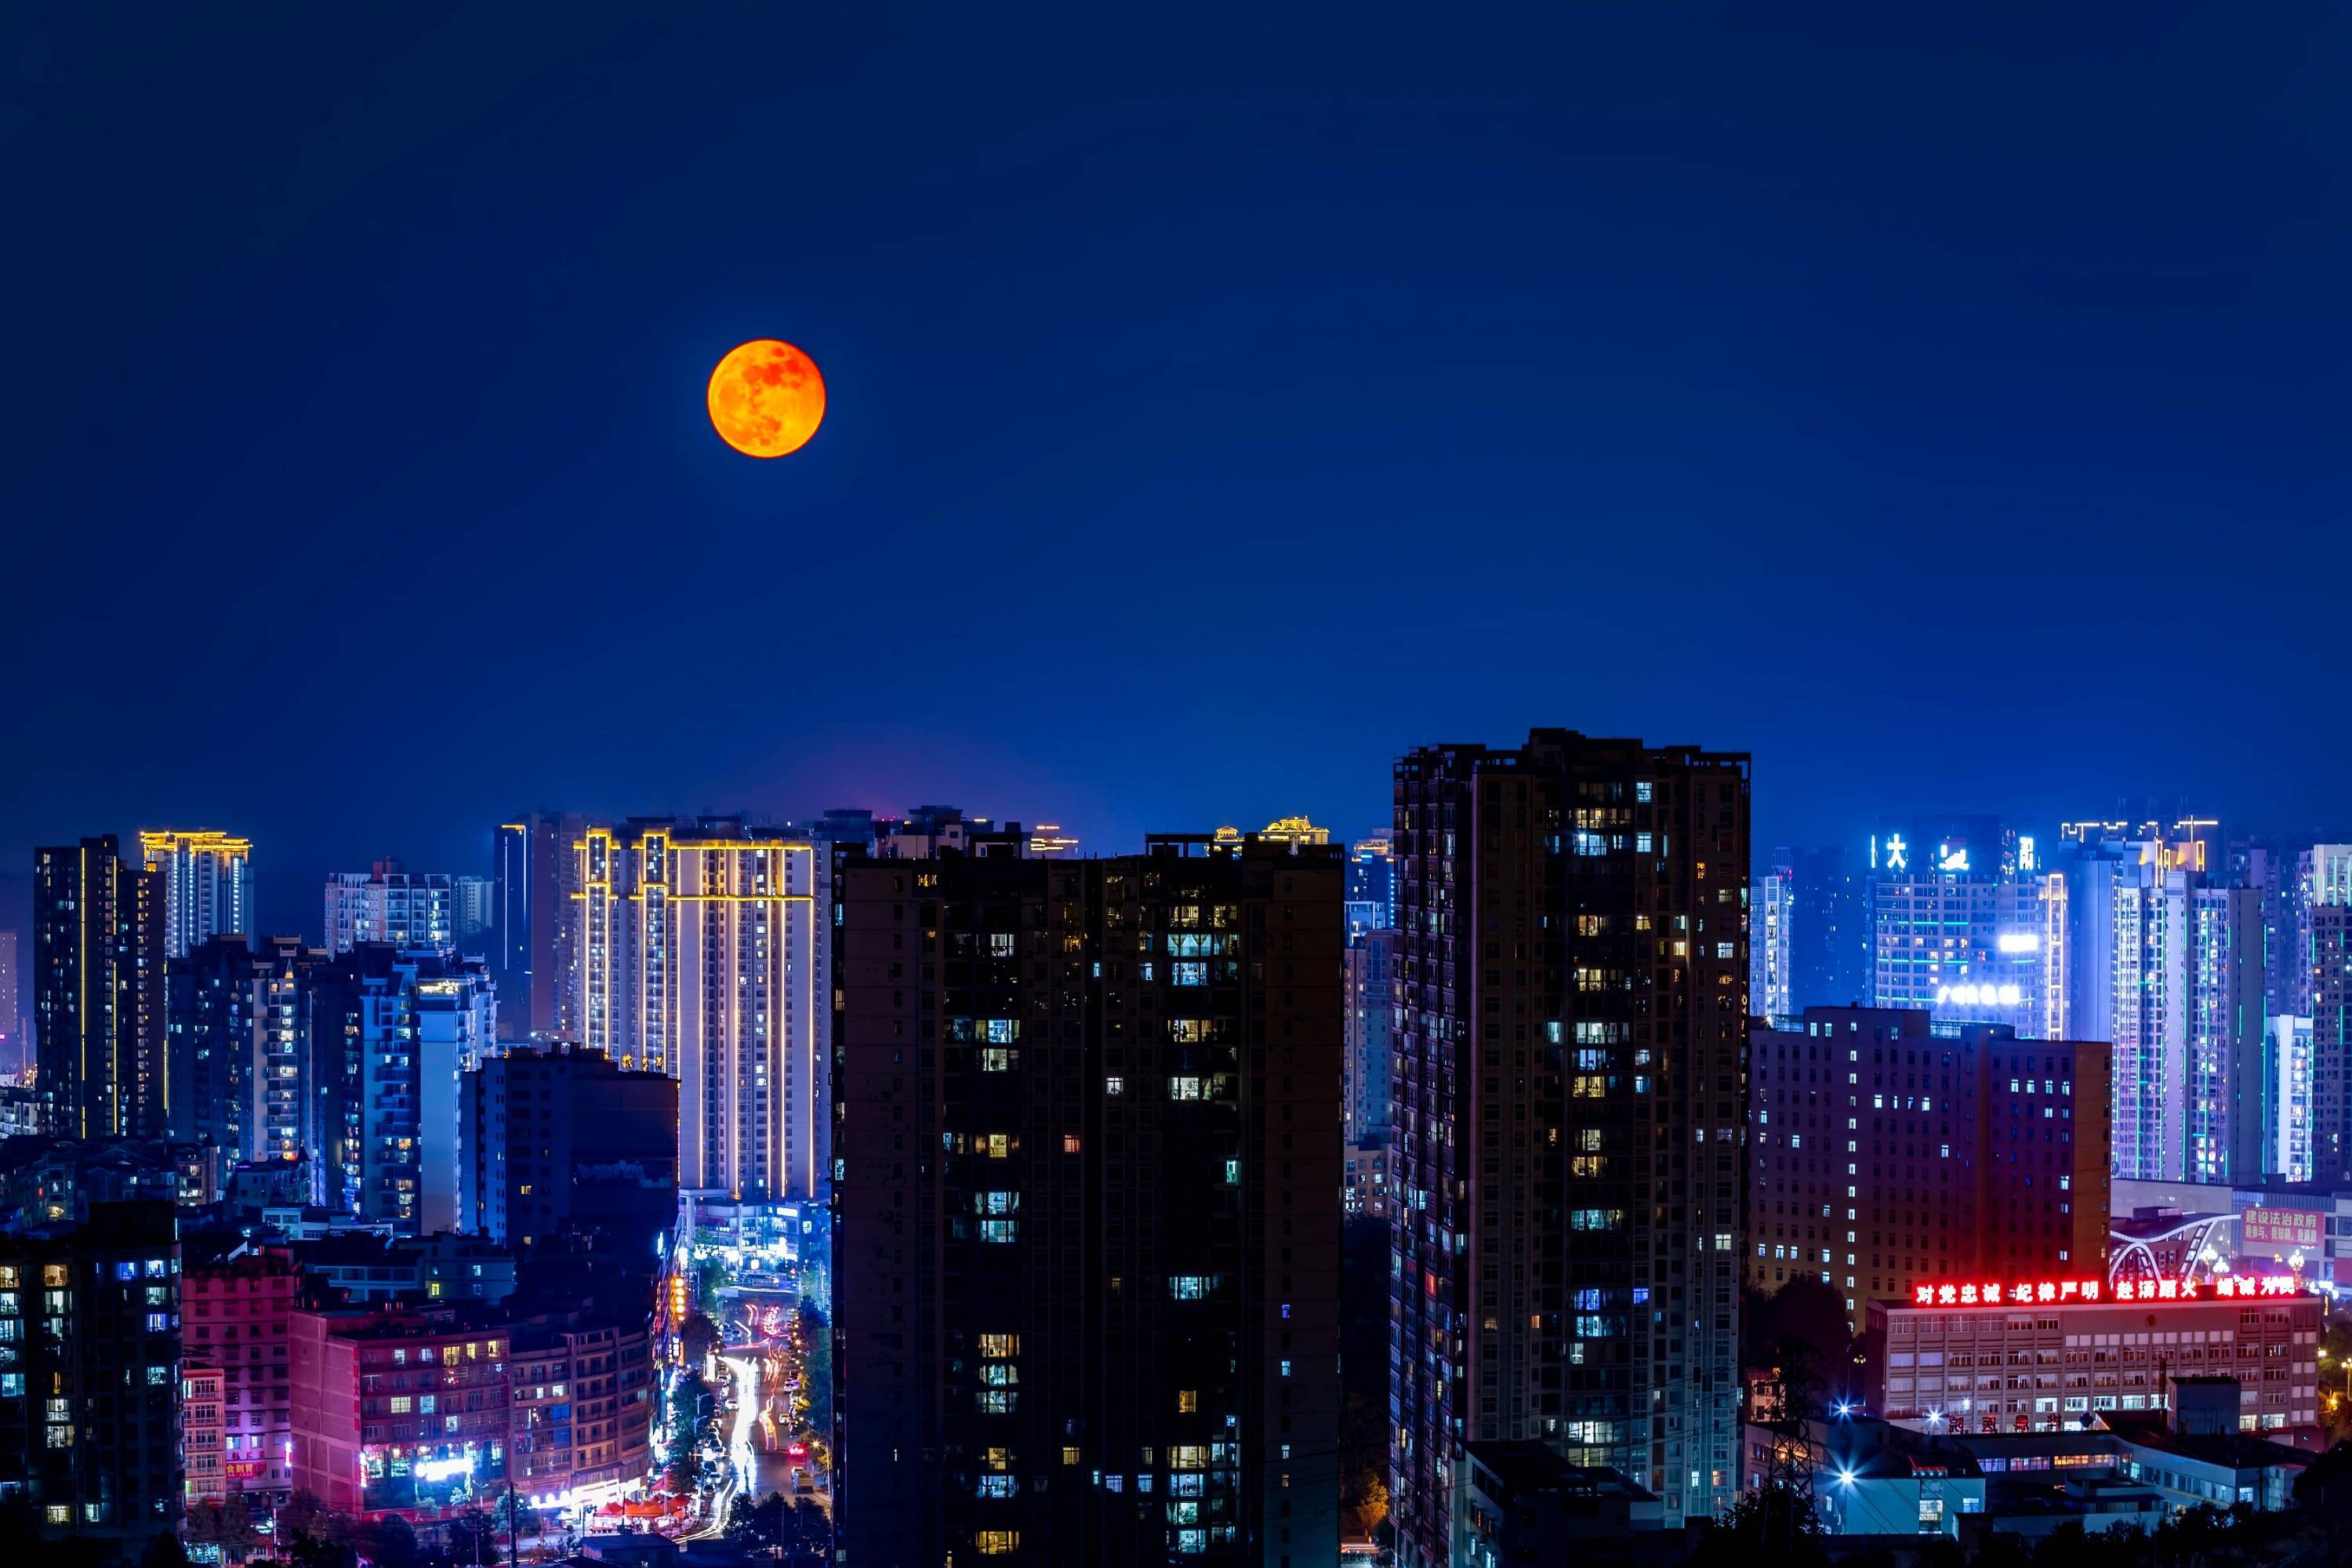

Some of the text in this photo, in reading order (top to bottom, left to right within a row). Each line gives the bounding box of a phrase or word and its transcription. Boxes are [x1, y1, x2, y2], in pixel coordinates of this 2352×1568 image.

[2245, 1210, 2317, 1228] 建设法治政府
[1916, 1283, 2001, 1305] 对党忠诚
[2016, 1280, 2099, 1302] 纪律严明
[2117, 1279, 2197, 1299] 赴汤蹈火
